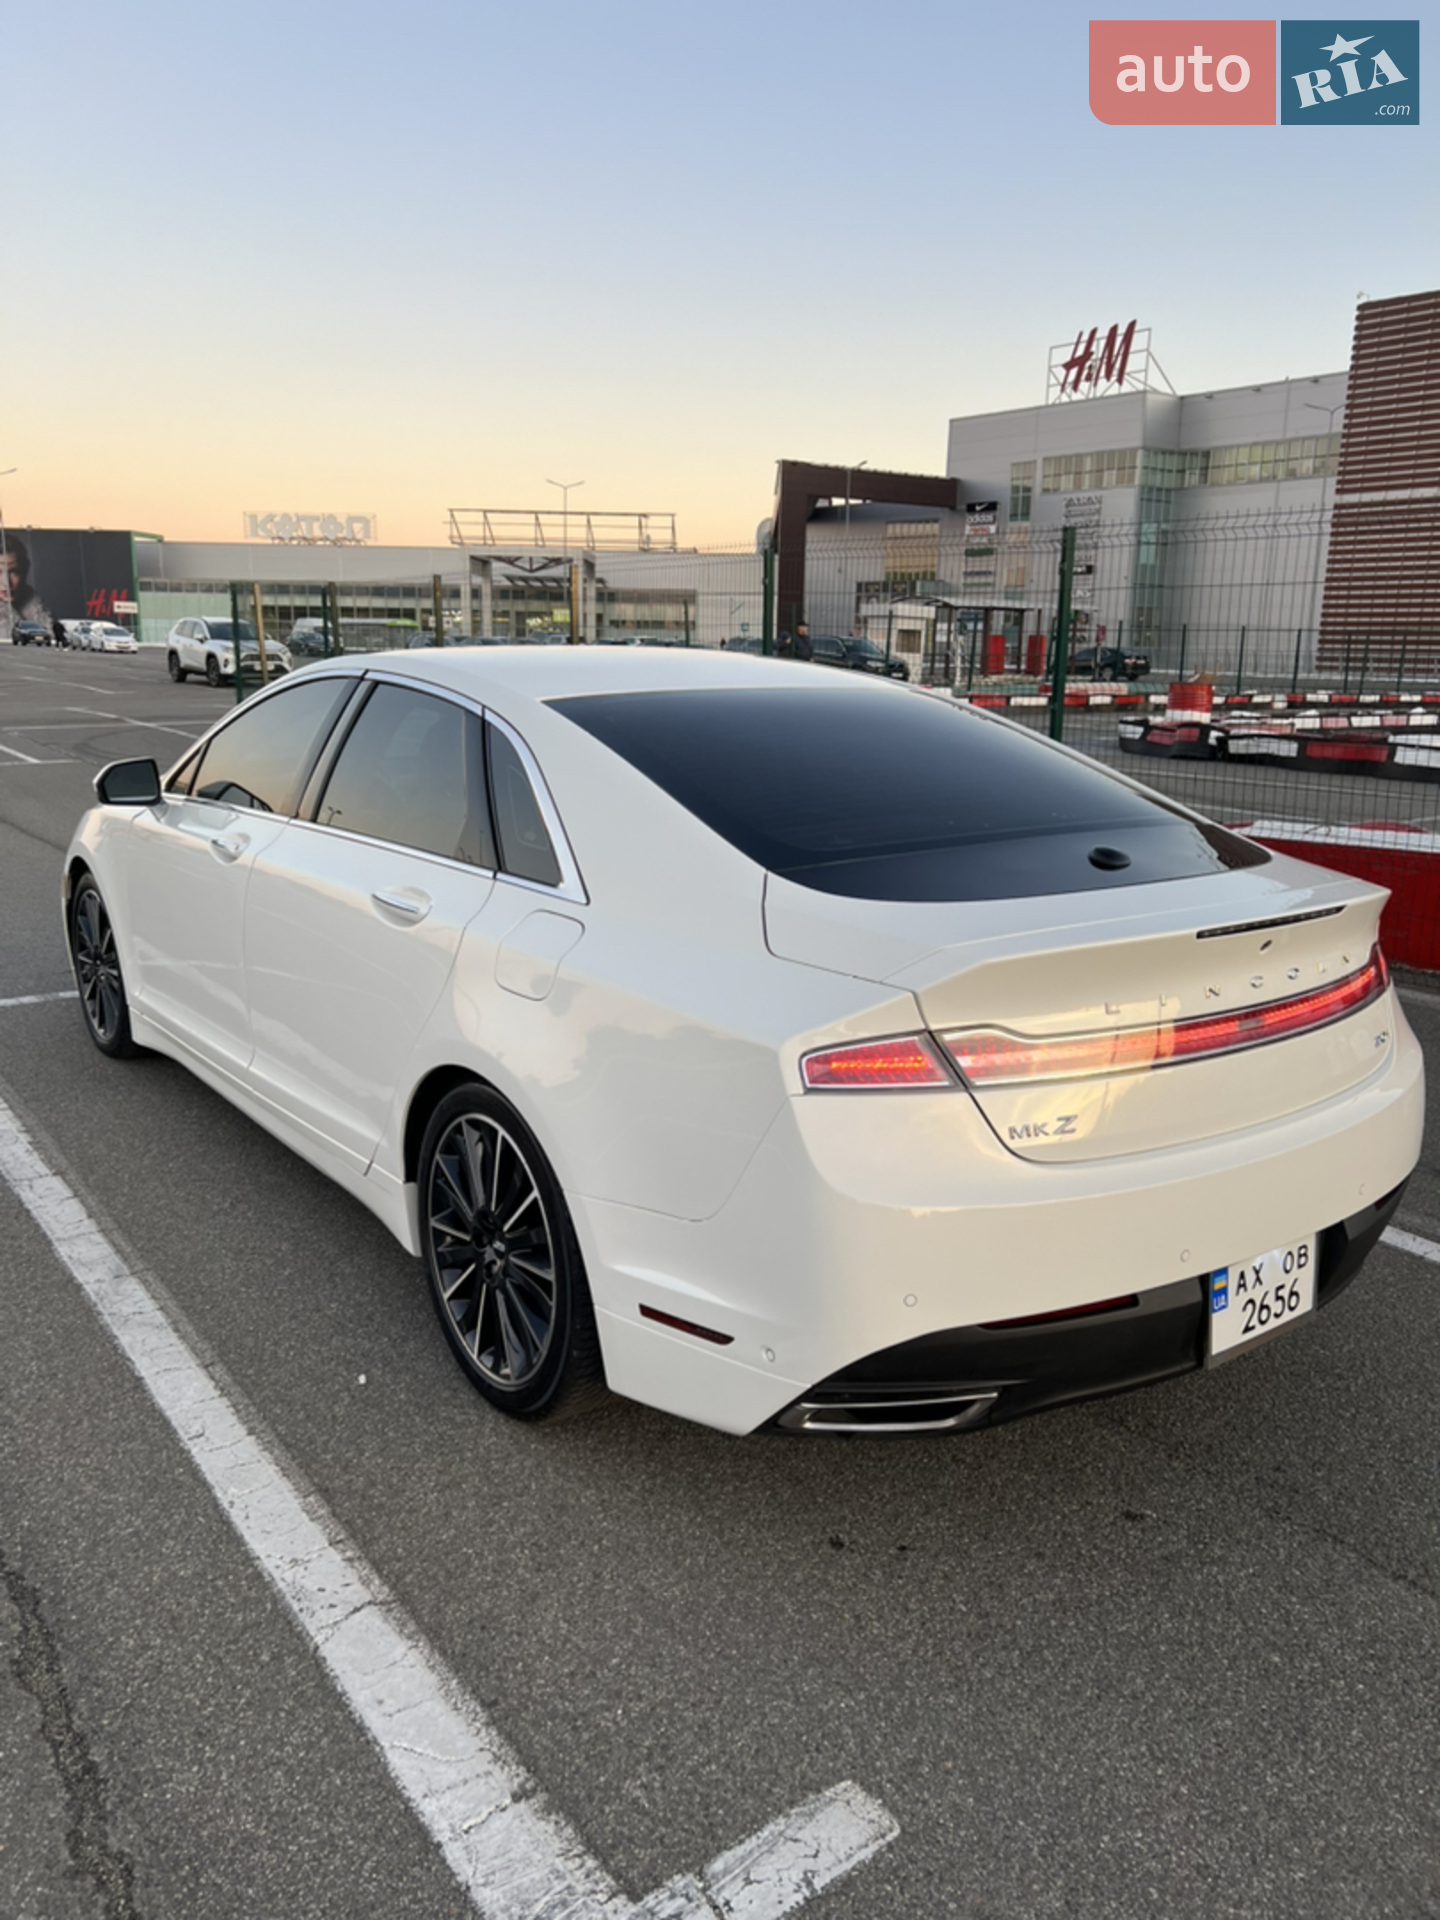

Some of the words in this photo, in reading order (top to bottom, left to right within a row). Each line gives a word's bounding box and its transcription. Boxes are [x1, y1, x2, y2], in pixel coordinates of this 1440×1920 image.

[1061, 318, 1137, 394] H&M
[1008, 1114, 1079, 1140] MKZ
[1236, 1262, 1264, 1296] AX
[1241, 1277, 1300, 1335] 2656
